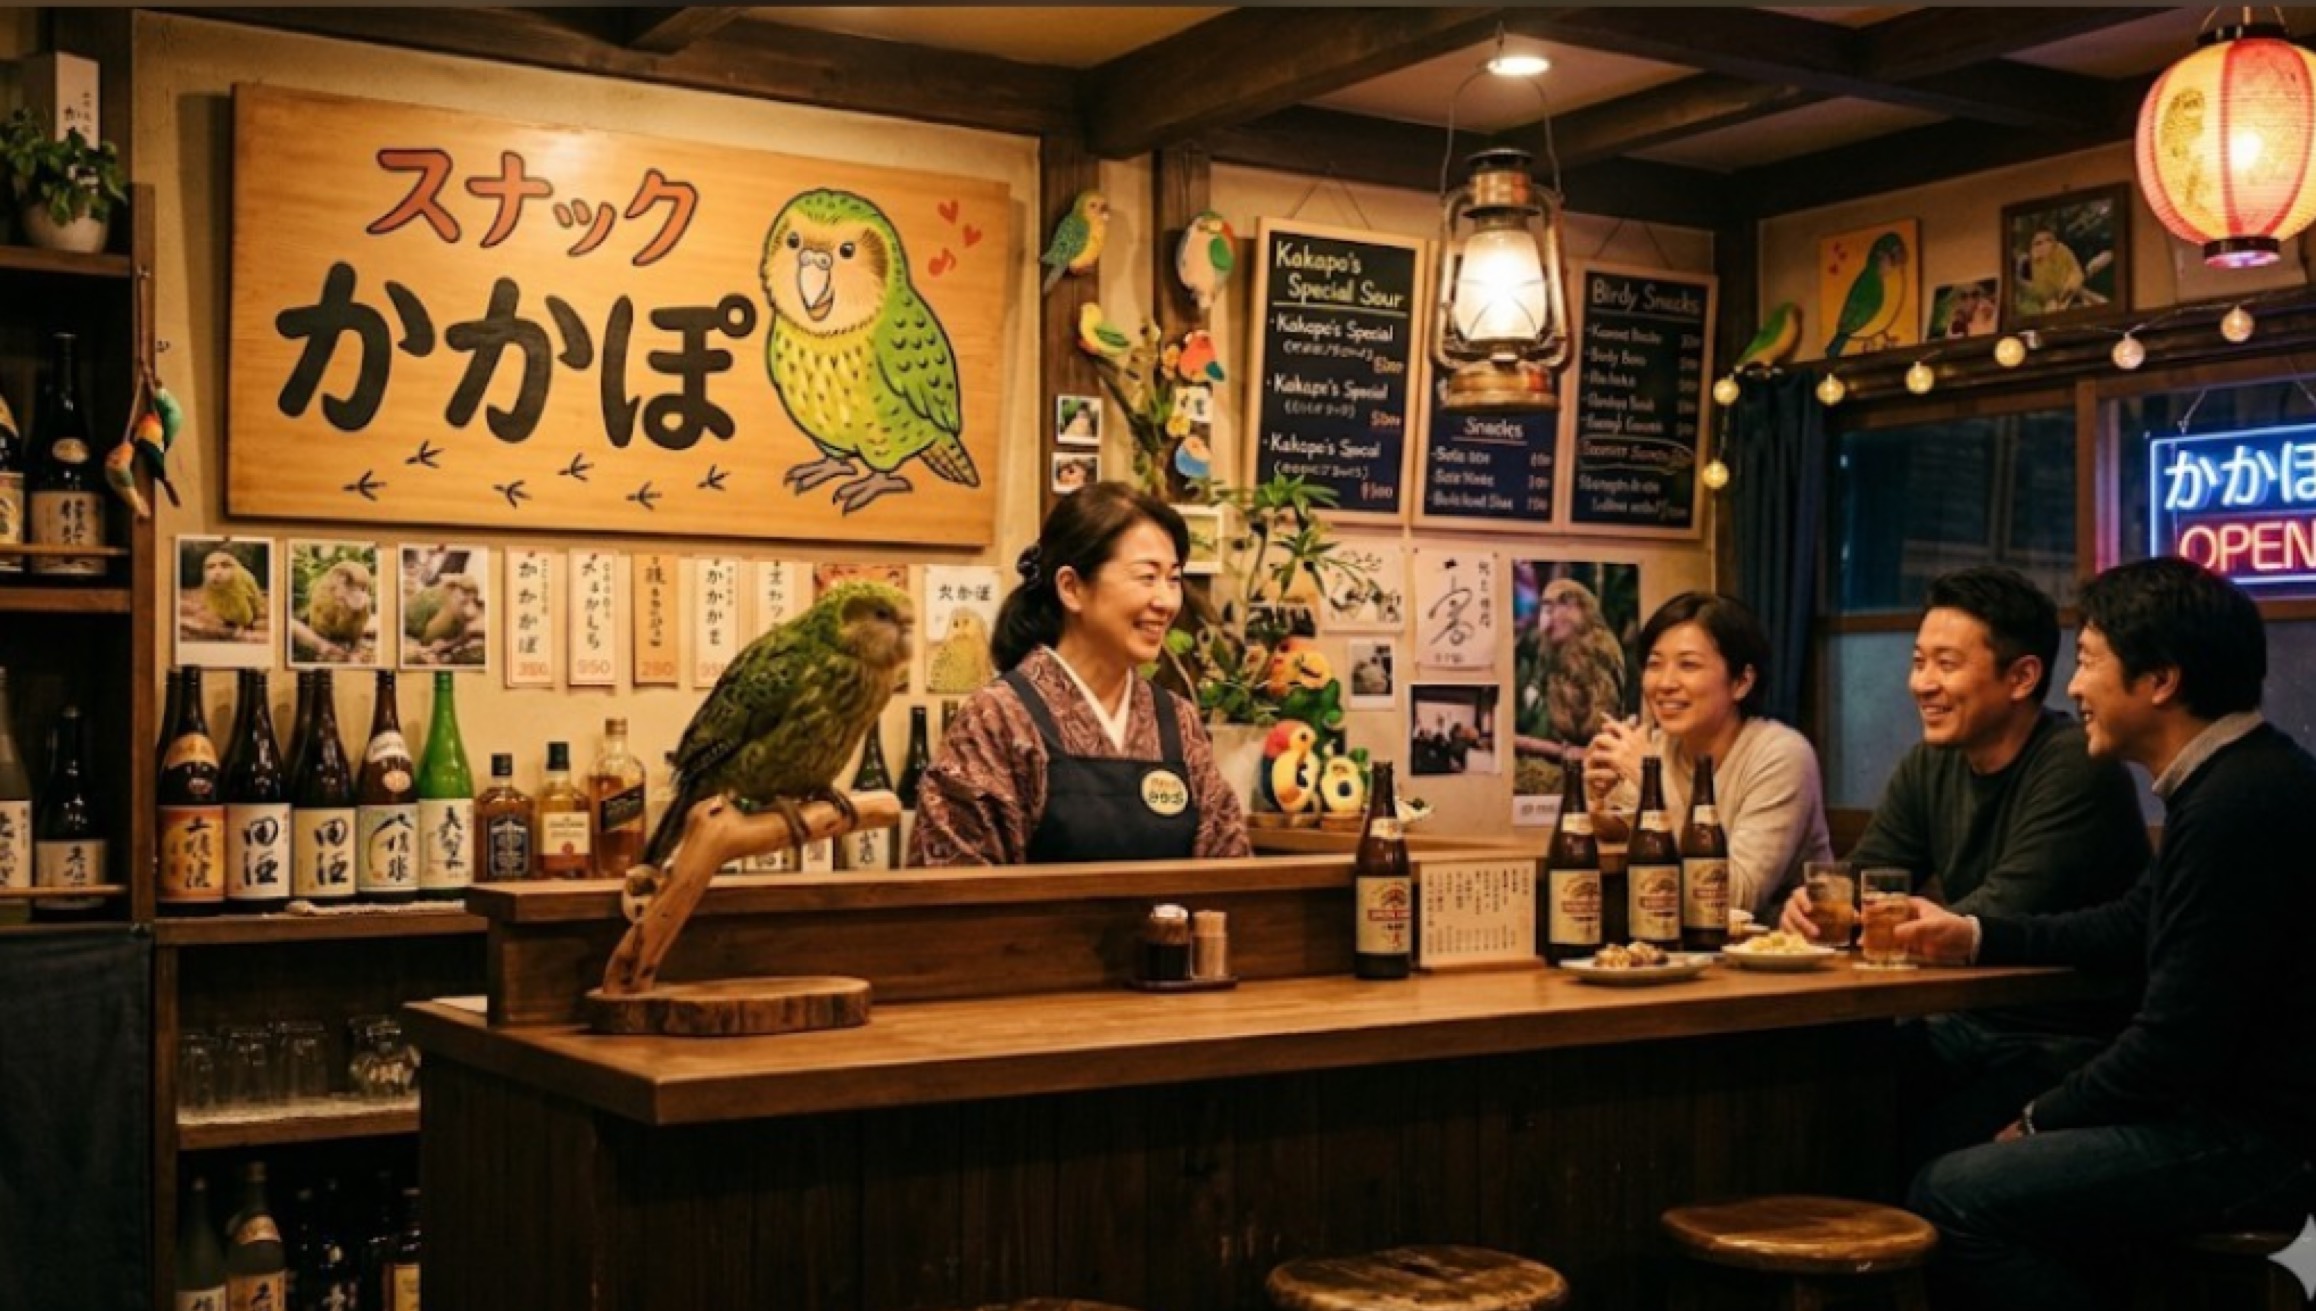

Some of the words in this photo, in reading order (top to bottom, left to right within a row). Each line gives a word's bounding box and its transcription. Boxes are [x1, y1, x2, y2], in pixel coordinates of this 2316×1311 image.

[366, 148, 699, 266] スナック
[1276, 241, 1361, 278] Kakapo's
[1288, 273, 1355, 305] Special
[1360, 279, 1404, 308] Sour
[275, 261, 757, 450] かかぽ
[2178, 519, 2316, 573] OPEN
